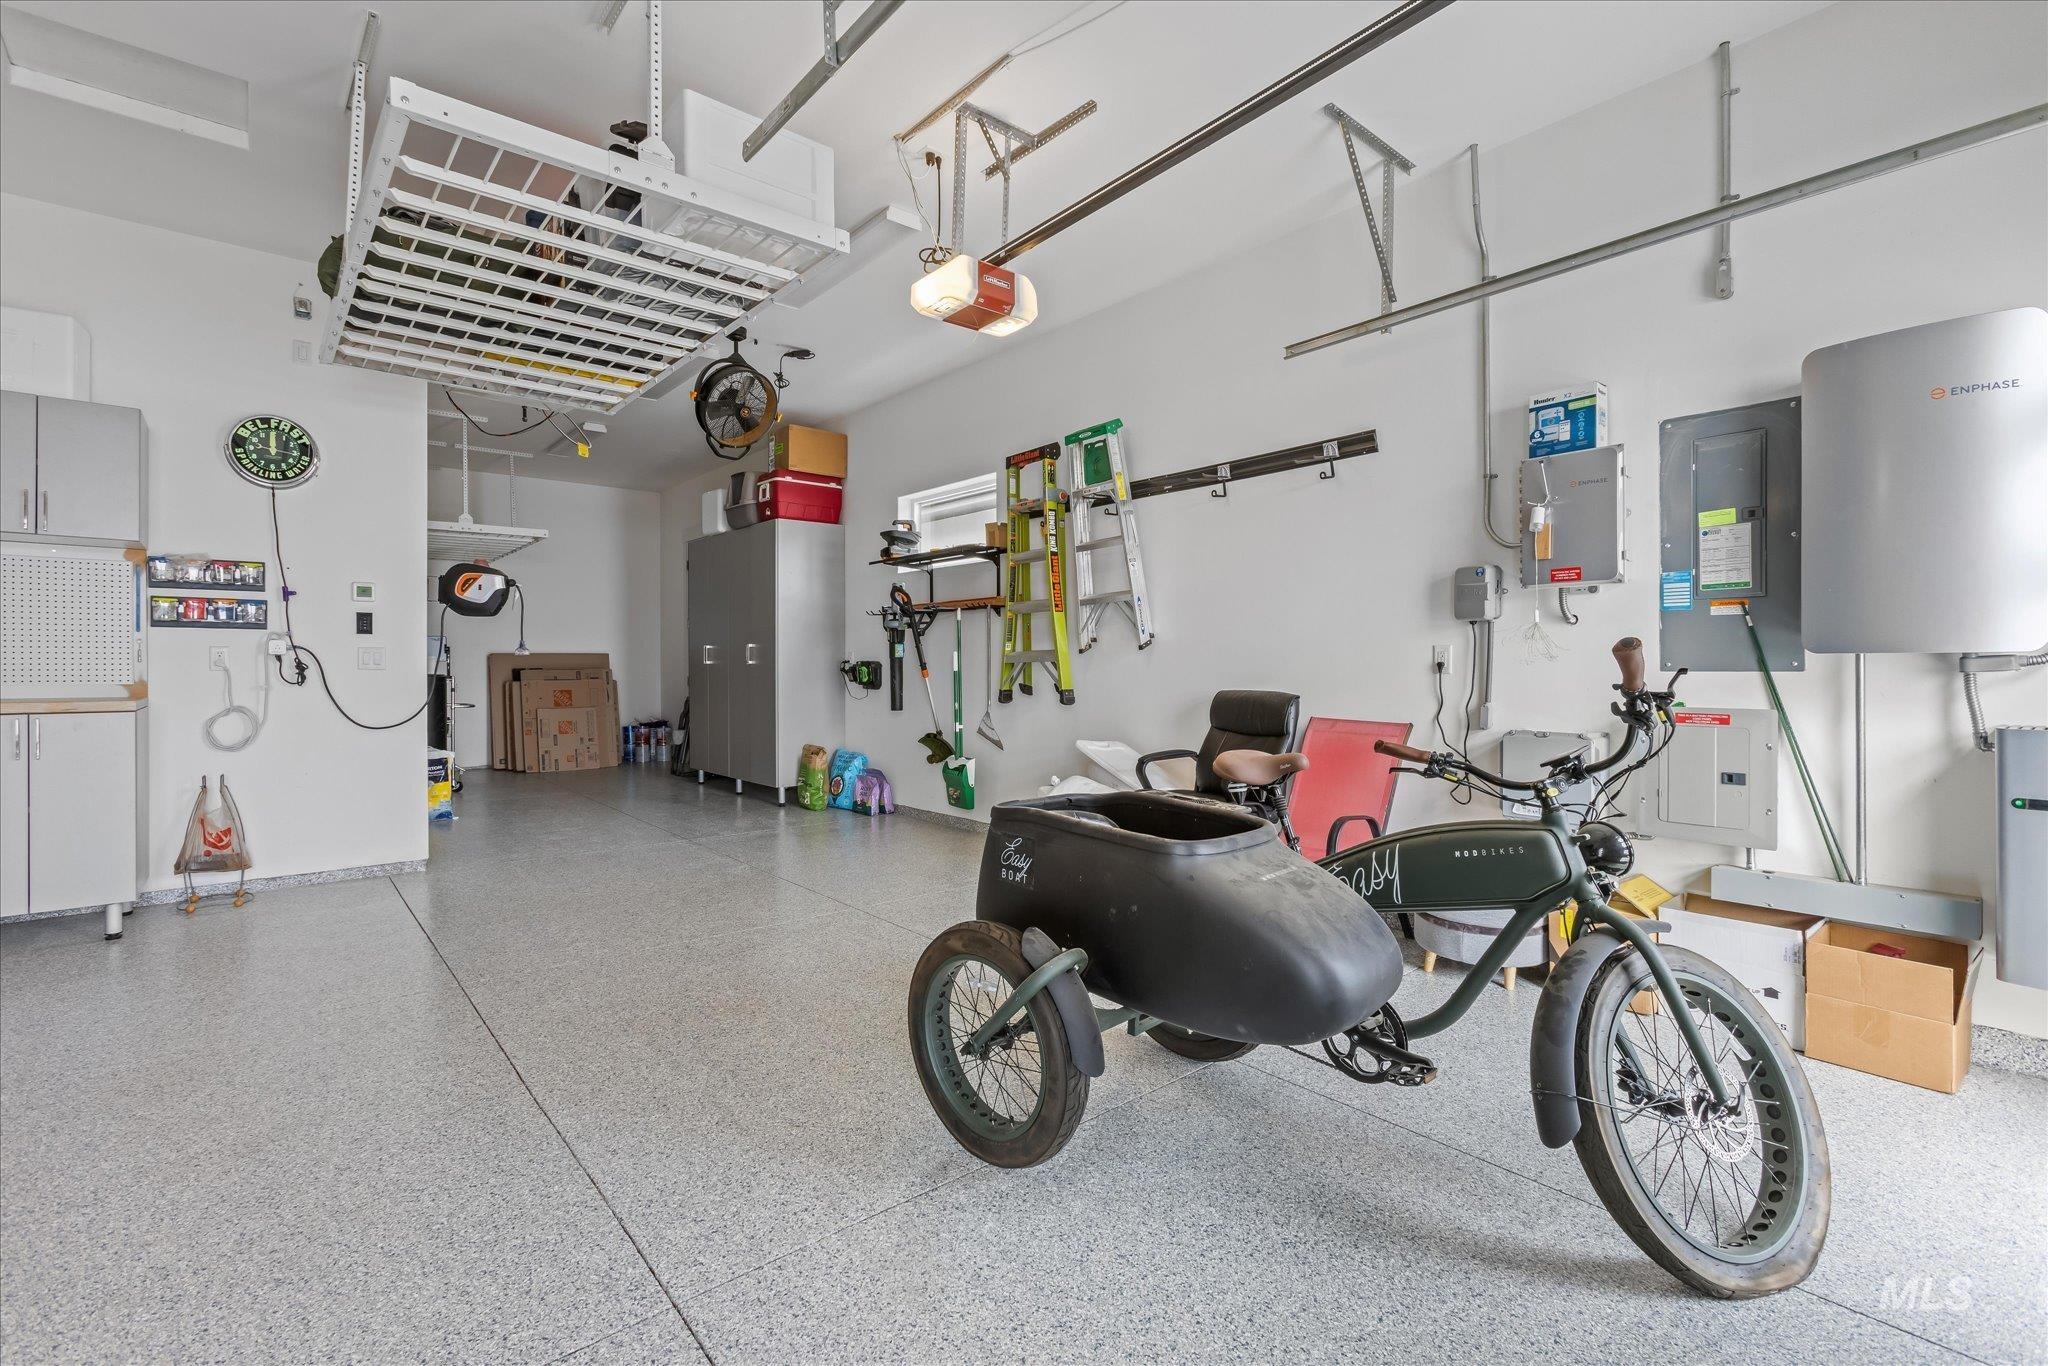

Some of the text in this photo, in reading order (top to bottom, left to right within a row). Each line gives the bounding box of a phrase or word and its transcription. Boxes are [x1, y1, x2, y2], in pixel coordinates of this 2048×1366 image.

[1950, 379, 2020, 396] ENPHASE
[236, 418, 311, 445] BELFAST
[235, 447, 311, 480] SPARKLING WATER
[1578, 478, 1608, 487] ENPHASE
[1001, 837, 1032, 878] Easy
[1001, 868, 1028, 884] BOAT
